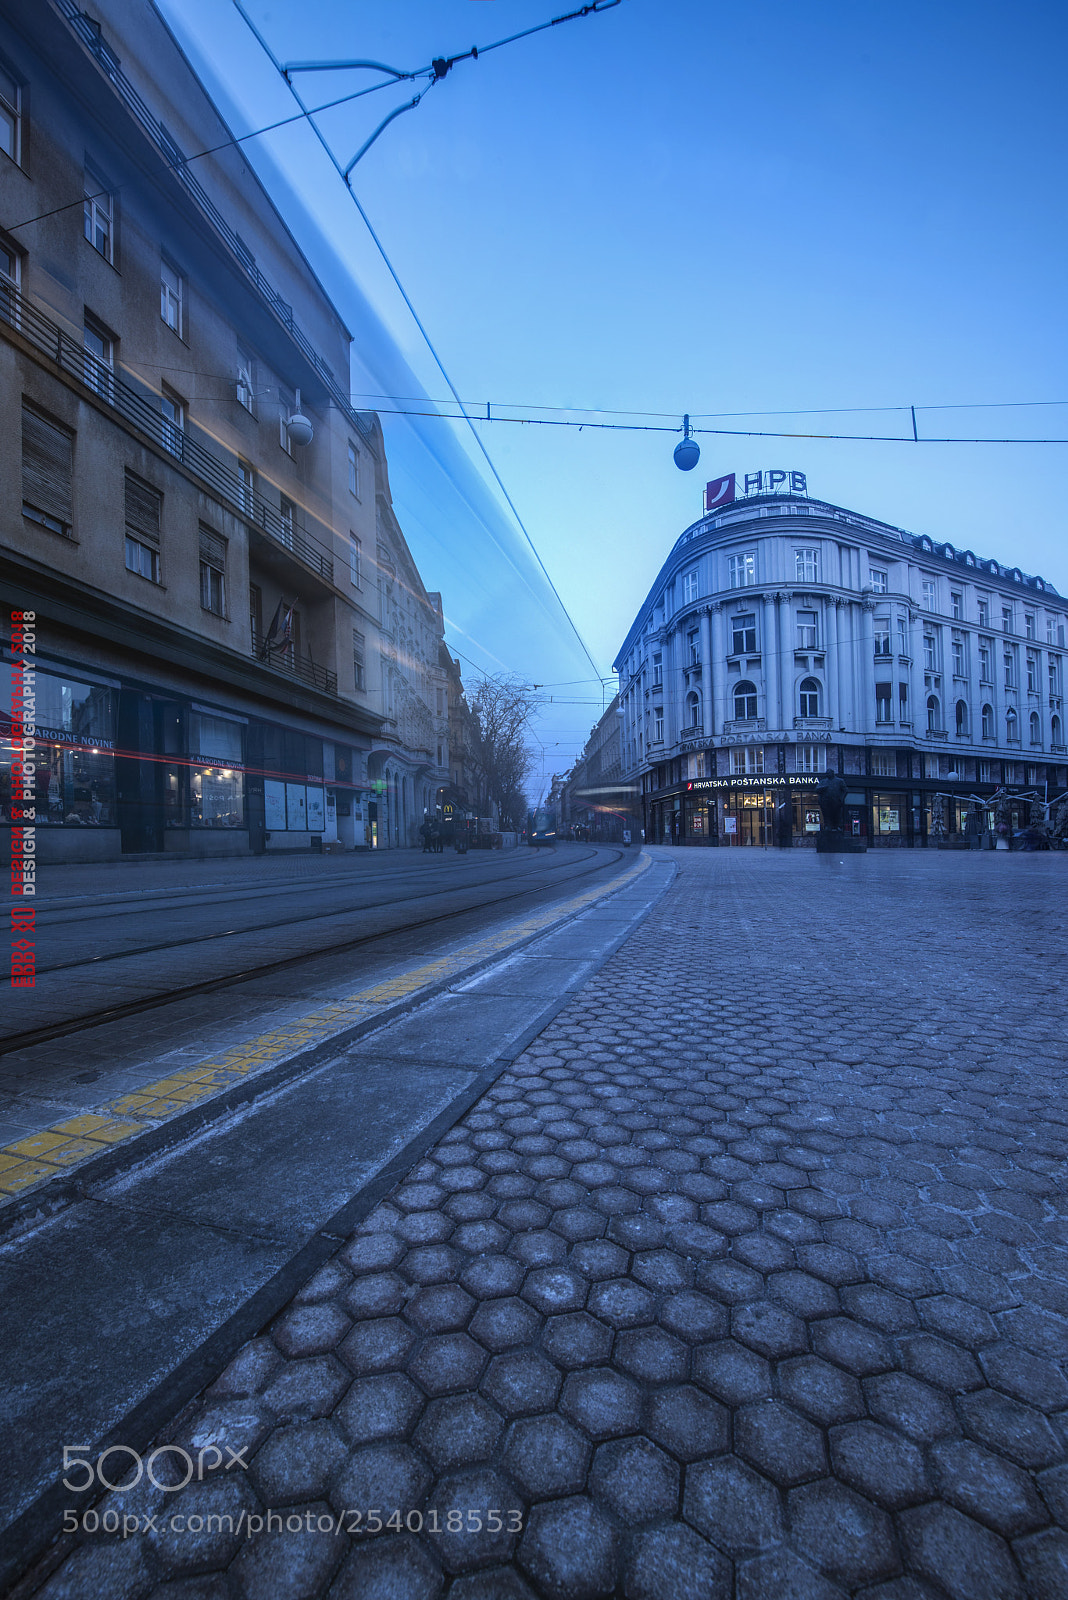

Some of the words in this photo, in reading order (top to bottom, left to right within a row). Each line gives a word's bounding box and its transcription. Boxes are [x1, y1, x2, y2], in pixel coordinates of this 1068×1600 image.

[744, 470, 807, 494] HPB
[27, 726, 78, 743] ARODNE
[81, 736, 114, 749] NOVINE
[680, 738, 715, 752] HRVATSKA
[721, 731, 790, 745] POŠTANSKA
[797, 731, 832, 742] BANKA
[693, 779, 728, 789] HRVATSKA
[731, 777, 786, 787] POŠTANSKA
[789, 776, 820, 784] BANKA
